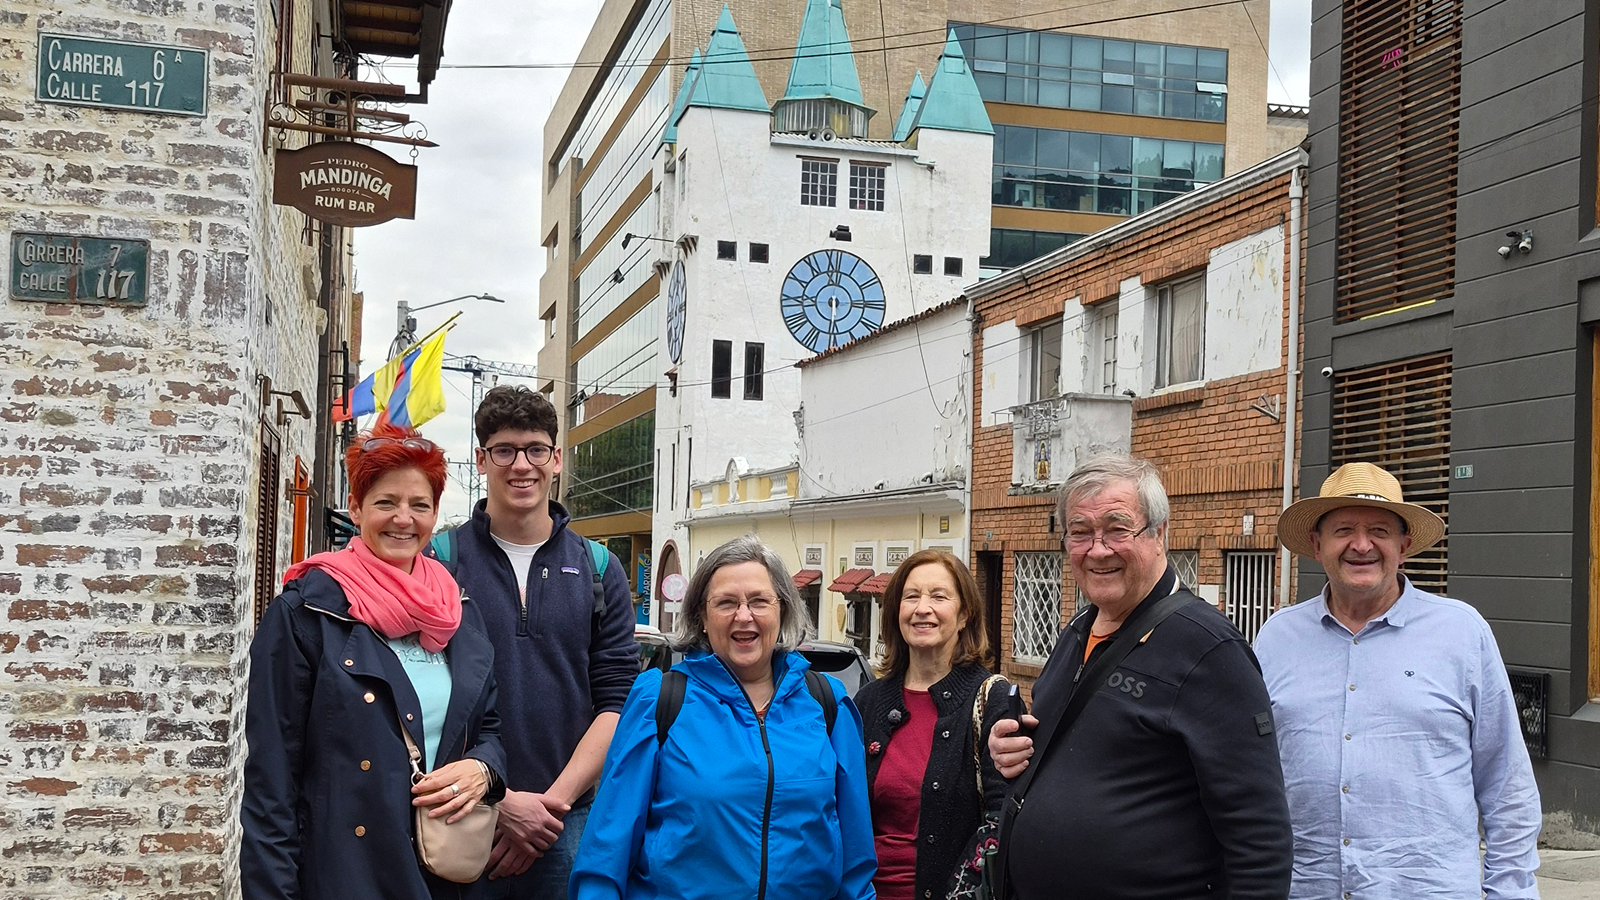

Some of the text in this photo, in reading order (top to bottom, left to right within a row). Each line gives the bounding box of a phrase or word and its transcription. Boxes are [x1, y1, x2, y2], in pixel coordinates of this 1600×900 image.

[48, 39, 182, 81] CARRERA 6 A
[47, 72, 164, 107] CALLE 117
[328, 158, 369, 170] PEDRO
[299, 168, 393, 201] MANDINGA
[315, 195, 375, 214] RUM BAR
[18, 237, 122, 267] CARRERA 7
[20, 269, 136, 300] CALLE 117
[642, 558, 651, 616] CITY PARKING
[1107, 671, 1147, 698] OSS
